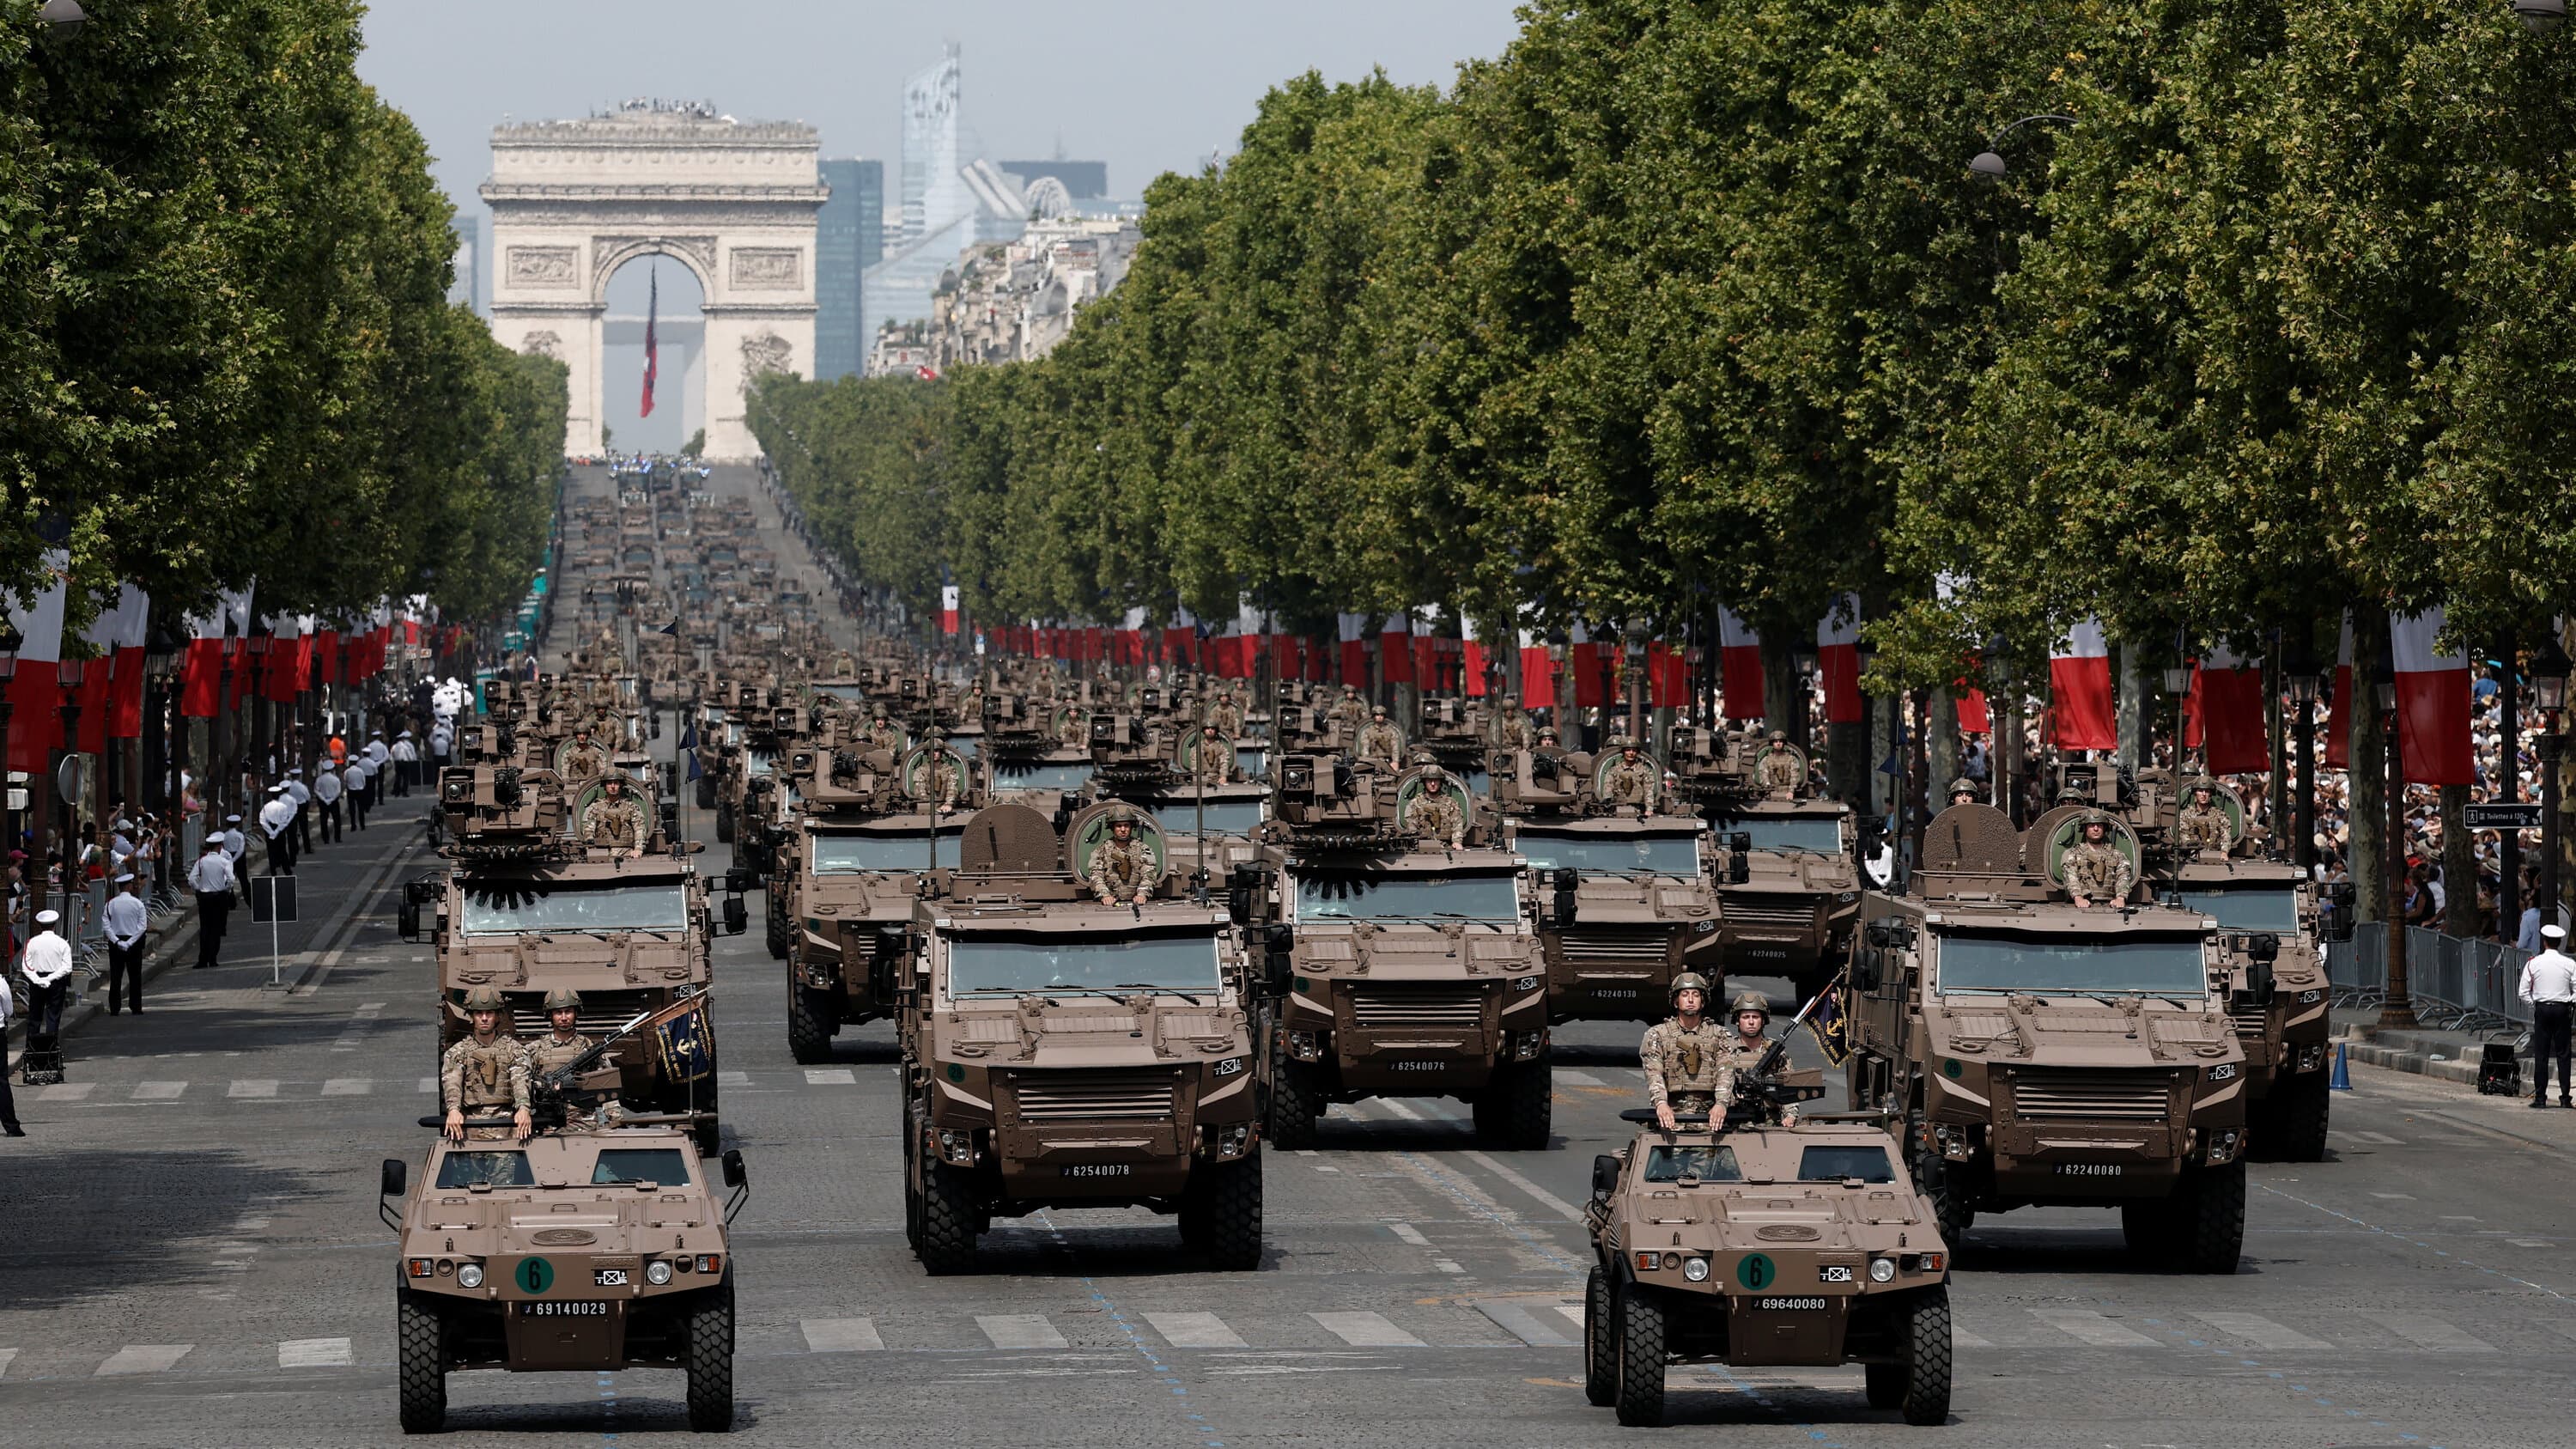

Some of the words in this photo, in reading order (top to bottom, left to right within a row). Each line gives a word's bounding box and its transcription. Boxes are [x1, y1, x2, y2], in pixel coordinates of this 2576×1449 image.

[1398, 1062, 1444, 1071] 62540076
[1073, 1165, 1129, 1176] 62540078
[2066, 1164, 2121, 1175] 62240080
[528, 1260, 541, 1291] 6
[1749, 1257, 1763, 1287] 6
[537, 1302, 606, 1315] 69140029
[1762, 1299, 1826, 1309] 69640080
